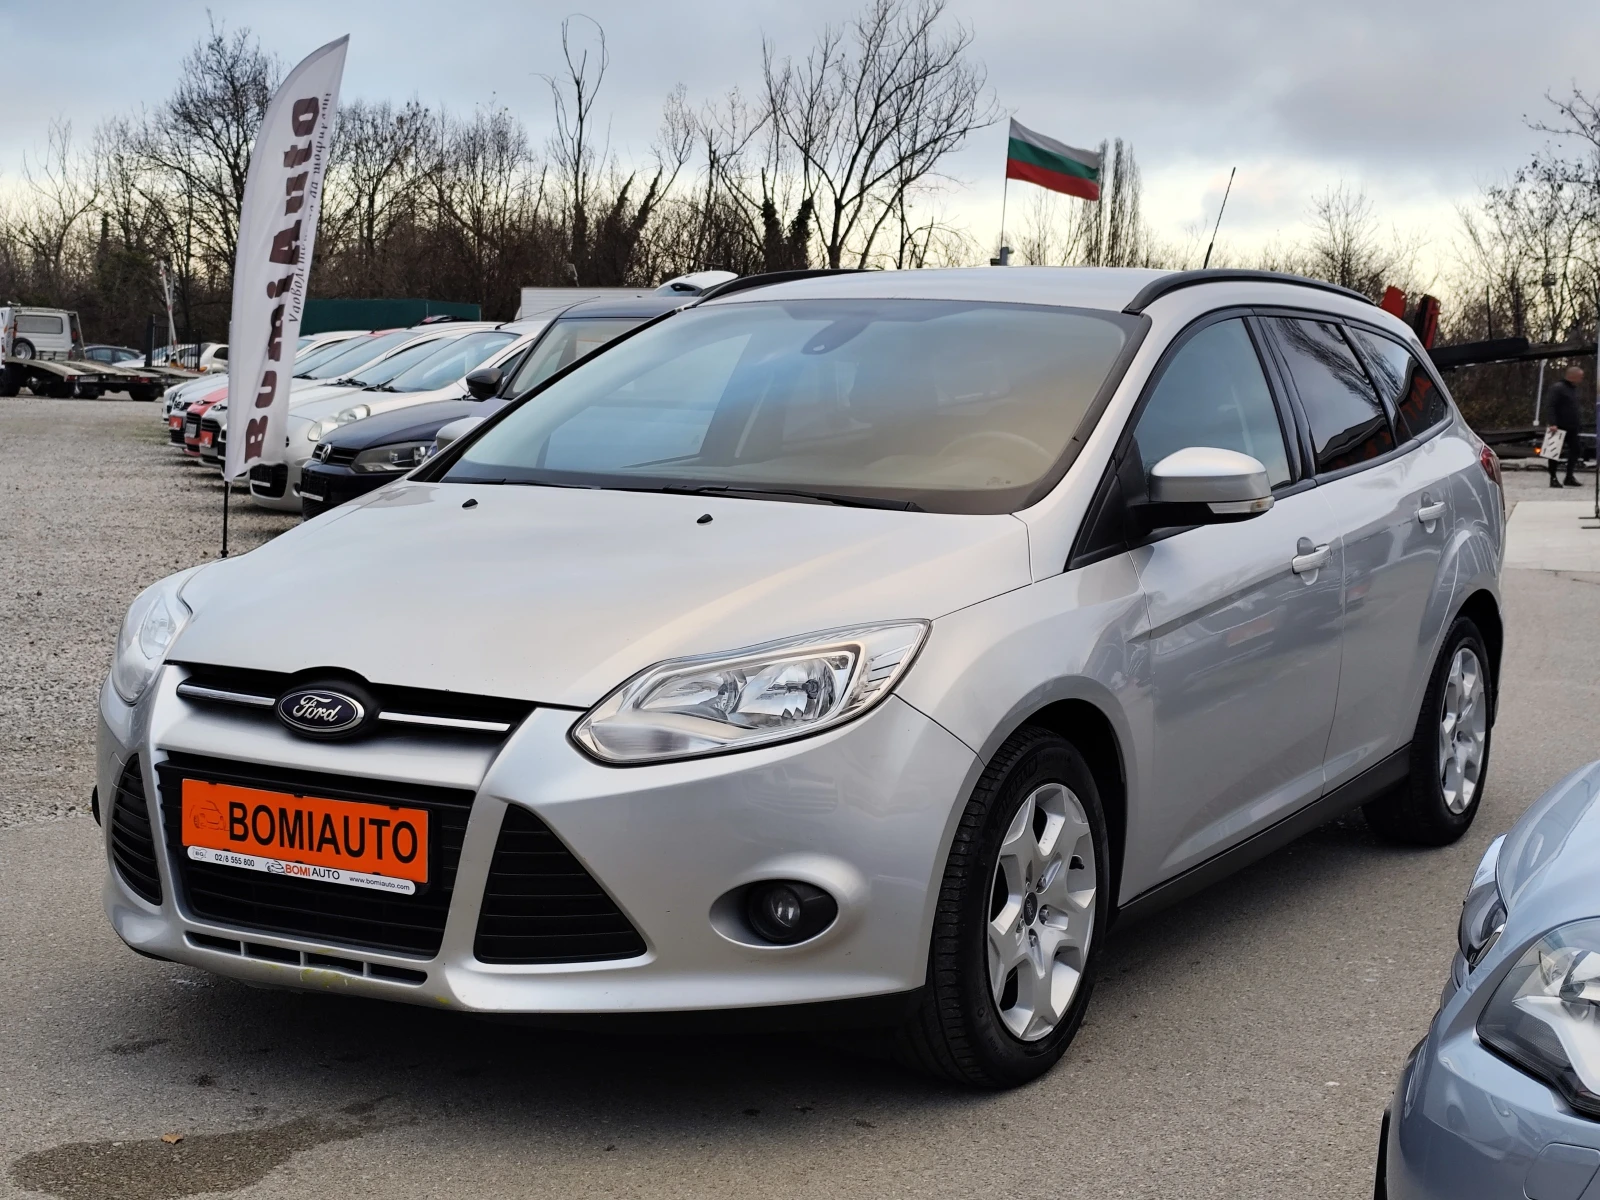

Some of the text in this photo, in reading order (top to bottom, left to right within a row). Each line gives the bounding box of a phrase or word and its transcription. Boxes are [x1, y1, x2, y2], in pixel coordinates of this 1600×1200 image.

[292, 695, 342, 722] Ford
[229, 801, 418, 864] BOMIAUTO
[214, 853, 229, 863] 02/8
[230, 856, 242, 865] 555
[285, 863, 340, 880] BOMI AUTO
[349, 876, 410, 891] www.bomiauto.com
